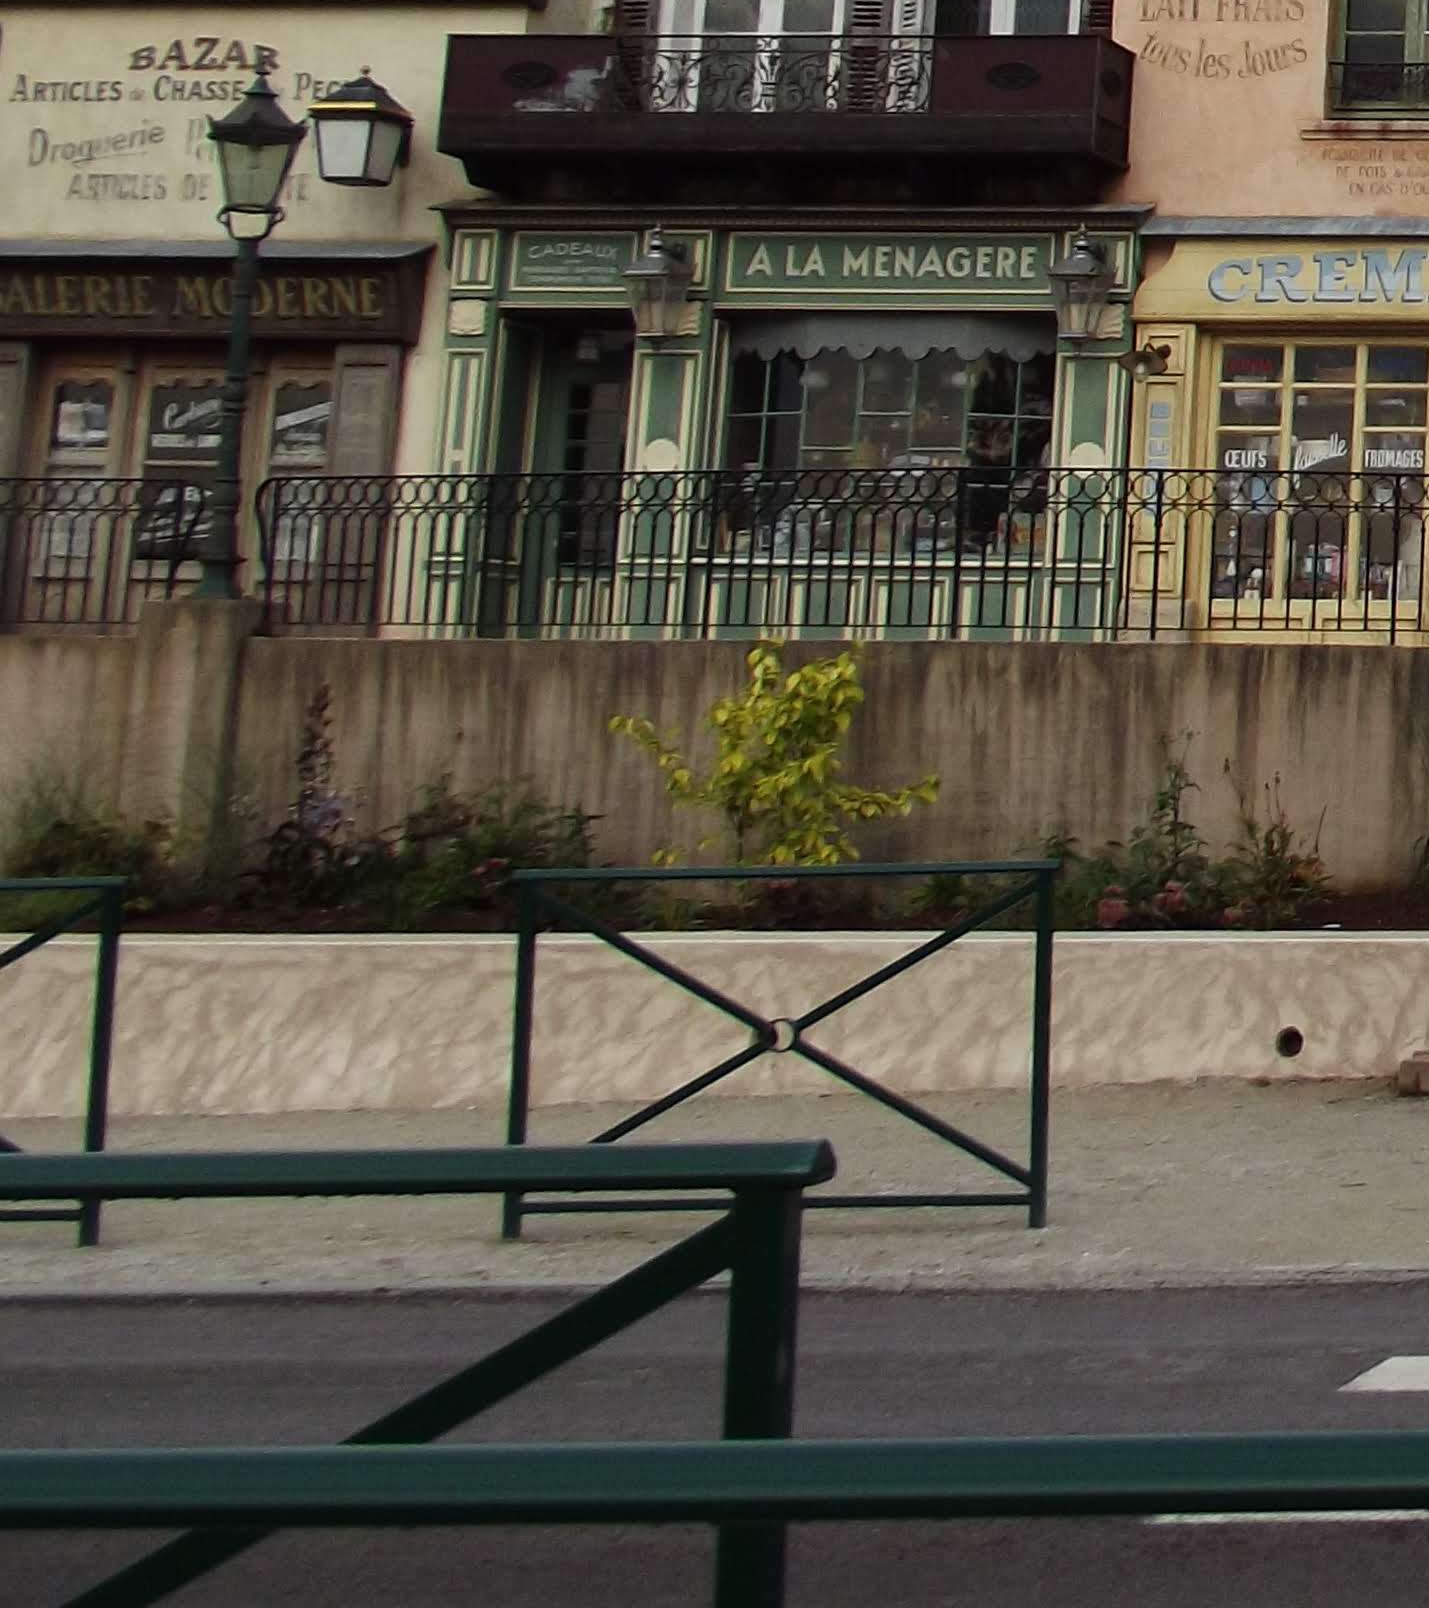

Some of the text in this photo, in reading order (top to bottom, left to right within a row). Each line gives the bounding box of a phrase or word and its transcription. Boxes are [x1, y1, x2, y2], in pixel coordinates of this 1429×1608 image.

[128, 37, 280, 73] BAZAR
[1194, 38, 1232, 79] les
[10, 74, 124, 102] ARTICLES
[154, 75, 245, 102] CHASSE
[27, 119, 165, 168] Droguerie
[65, 172, 168, 201] ARTICLES
[527, 242, 618, 259] CADEAUX
[746, 242, 1038, 279] A LA MENAGERE
[0, 275, 384, 319] ALERIE MODERNE
[1224, 449, 1267, 469] ŒUFS
[1364, 448, 1424, 469] FROMAGES
